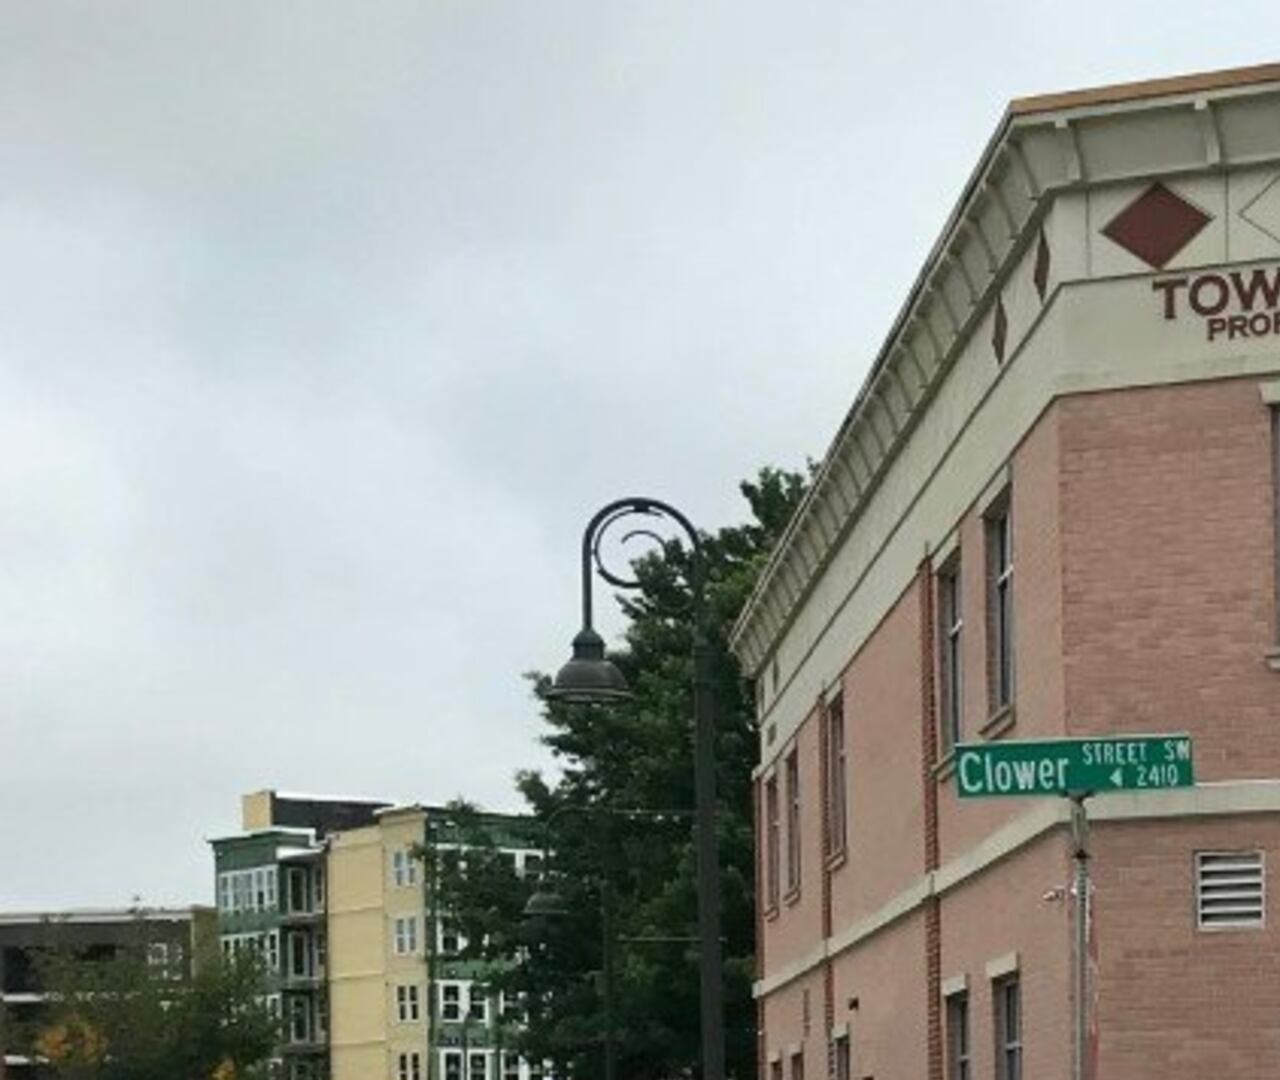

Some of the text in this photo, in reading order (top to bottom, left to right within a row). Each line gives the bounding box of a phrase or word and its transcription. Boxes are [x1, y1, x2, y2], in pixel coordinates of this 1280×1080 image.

[1081, 740, 1191, 766] STREET SW
[958, 752, 1069, 793] Clower
[1136, 764, 1178, 786] 2410
